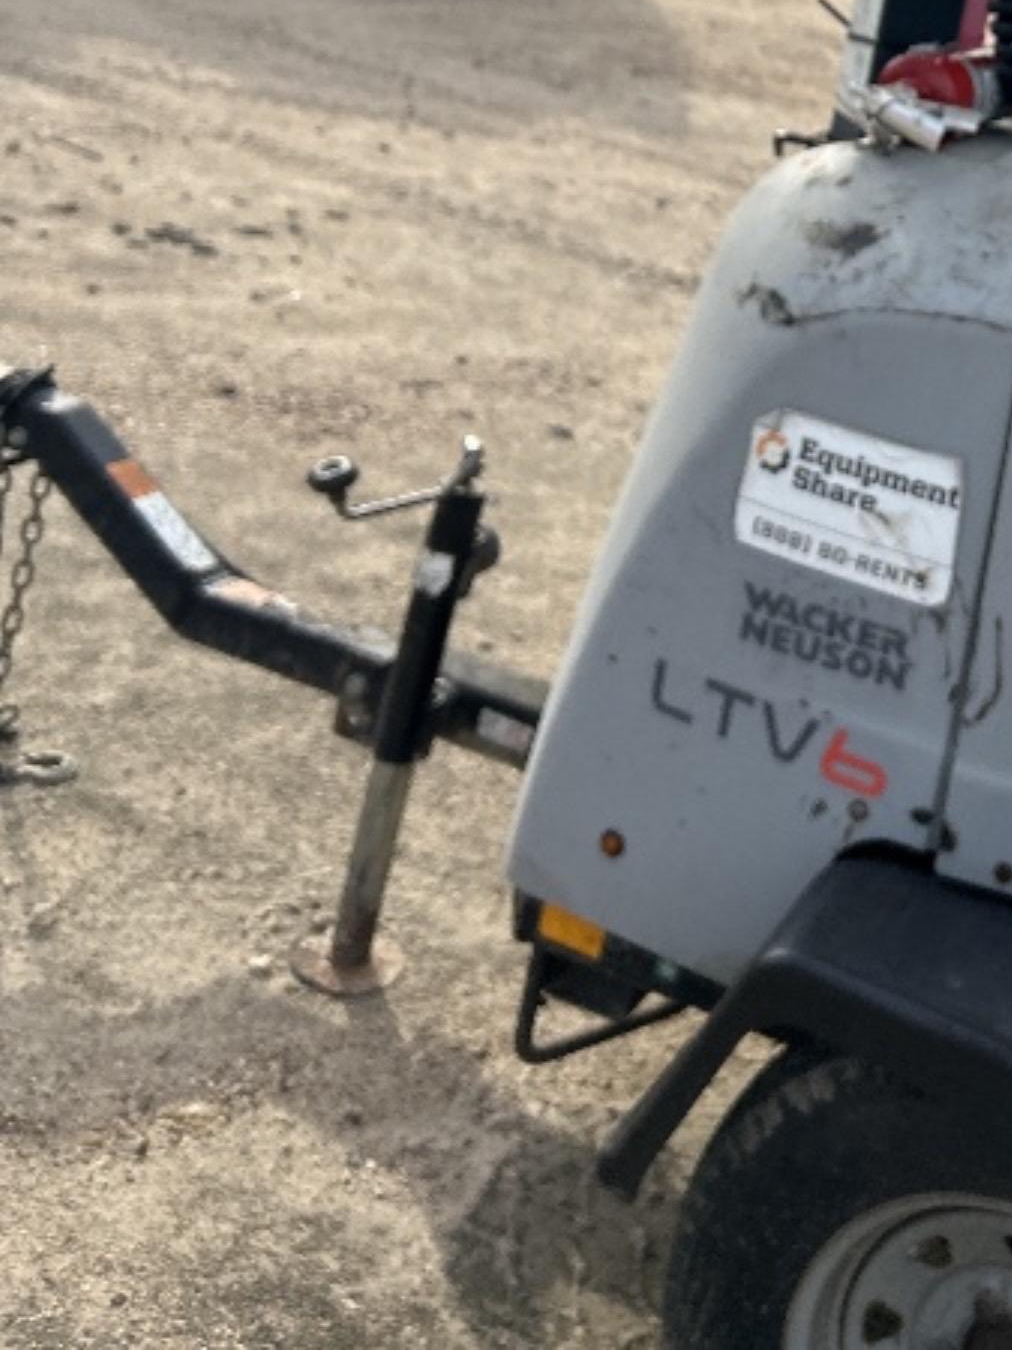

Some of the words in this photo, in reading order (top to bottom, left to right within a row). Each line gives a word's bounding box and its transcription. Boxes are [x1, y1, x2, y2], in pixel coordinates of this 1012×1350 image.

[792, 465, 877, 511] Share
[797, 437, 959, 509] Equipment
[752, 515, 813, 554] (888)
[739, 611, 912, 691] NEUSON
[744, 580, 909, 659] WACKER
[652, 656, 887, 799] LTV6
